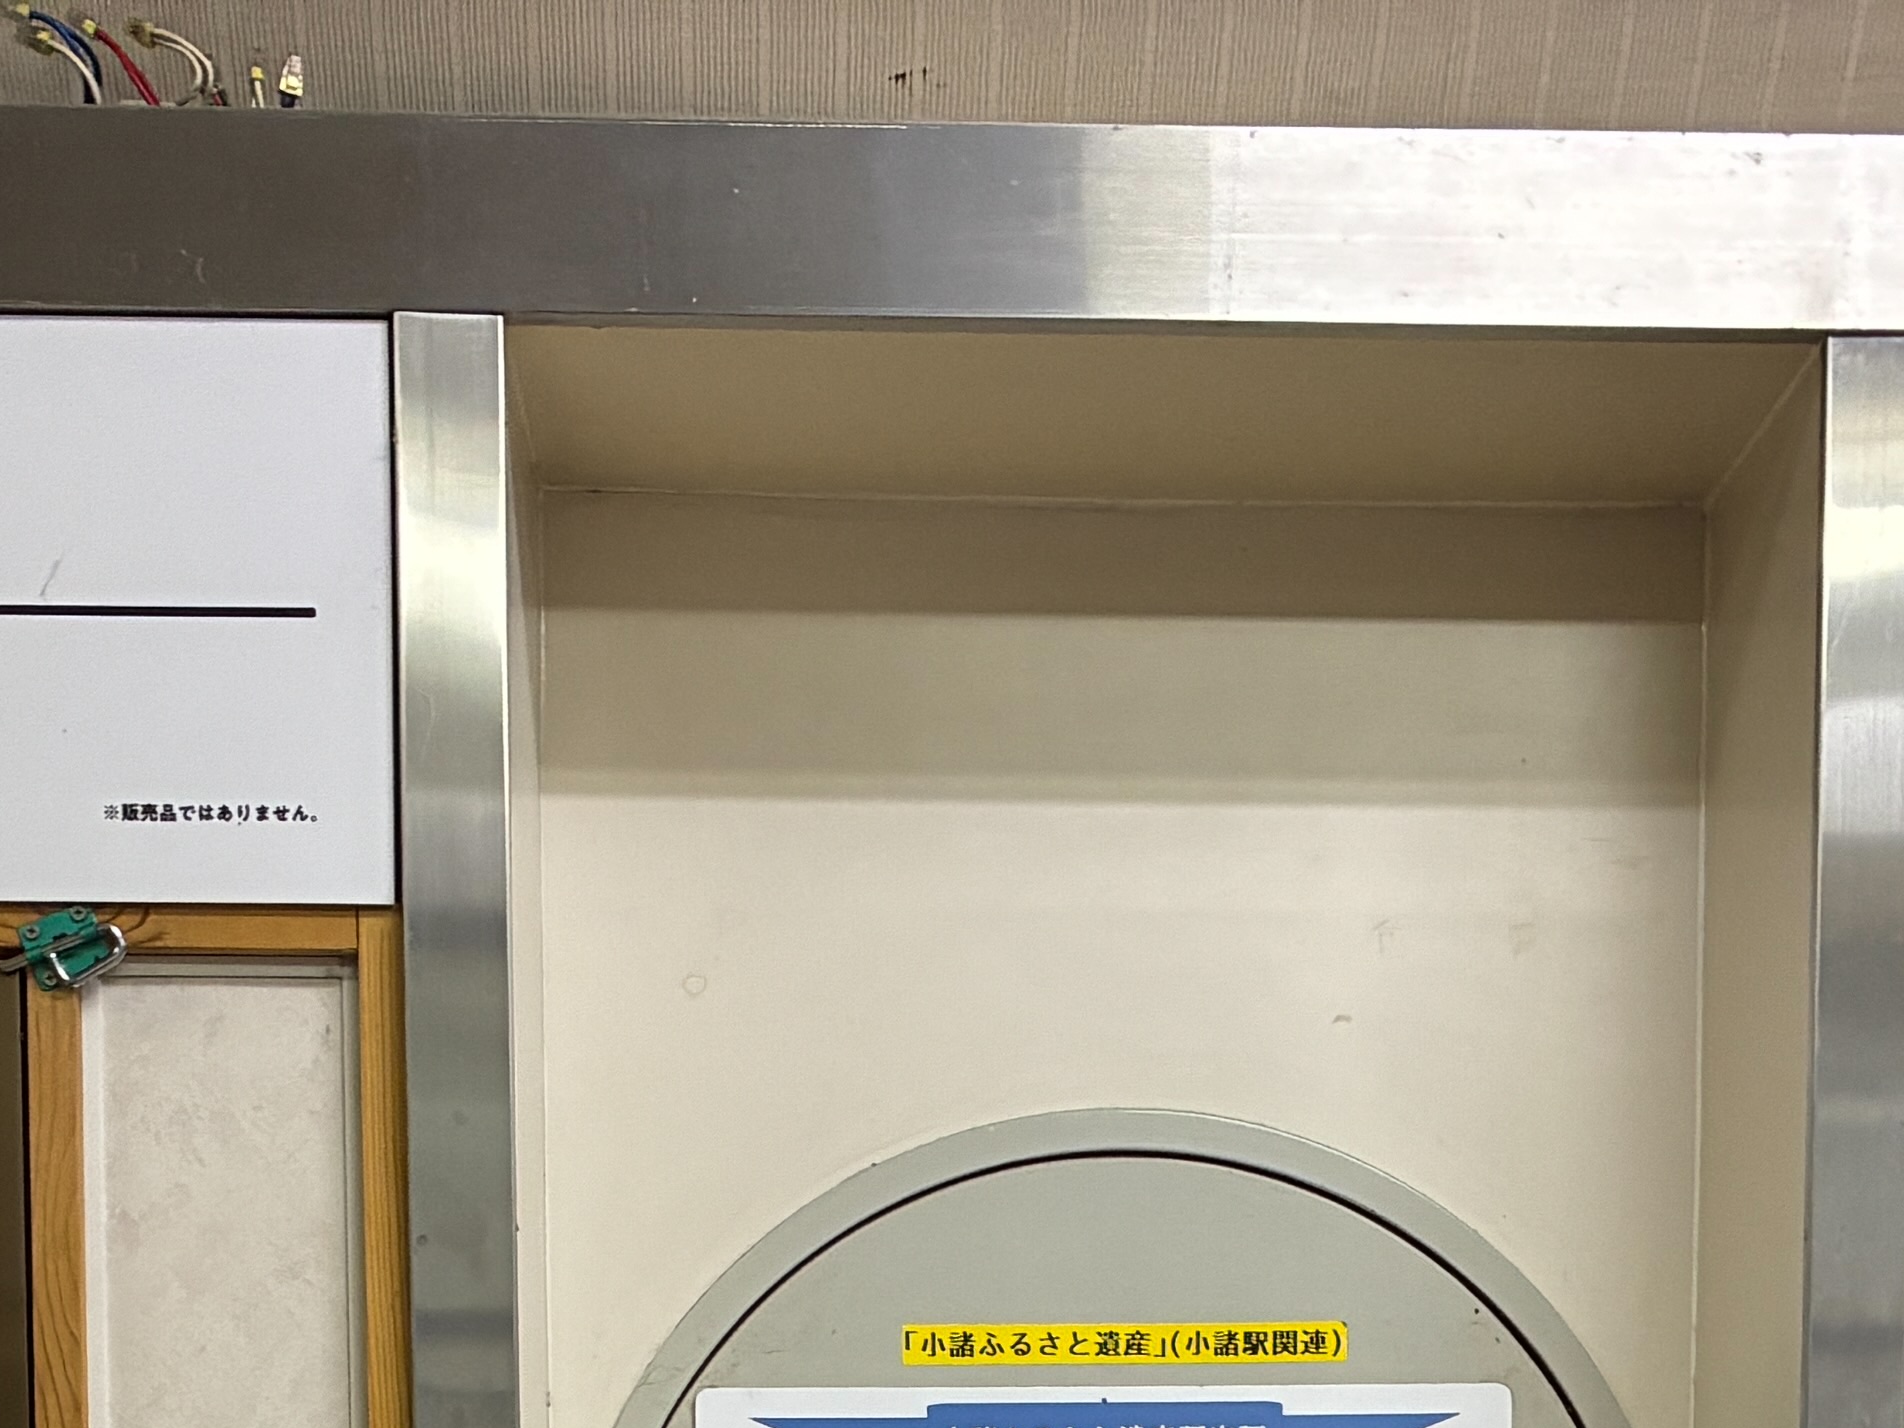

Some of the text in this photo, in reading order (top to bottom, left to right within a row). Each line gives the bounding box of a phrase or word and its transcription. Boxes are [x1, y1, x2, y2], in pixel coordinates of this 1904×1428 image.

[104, 804, 318, 822] ※販売品ではありません。
[904, 1328, 1341, 1357] 「小諸ふるさと遺産」(小諸駅関連)
